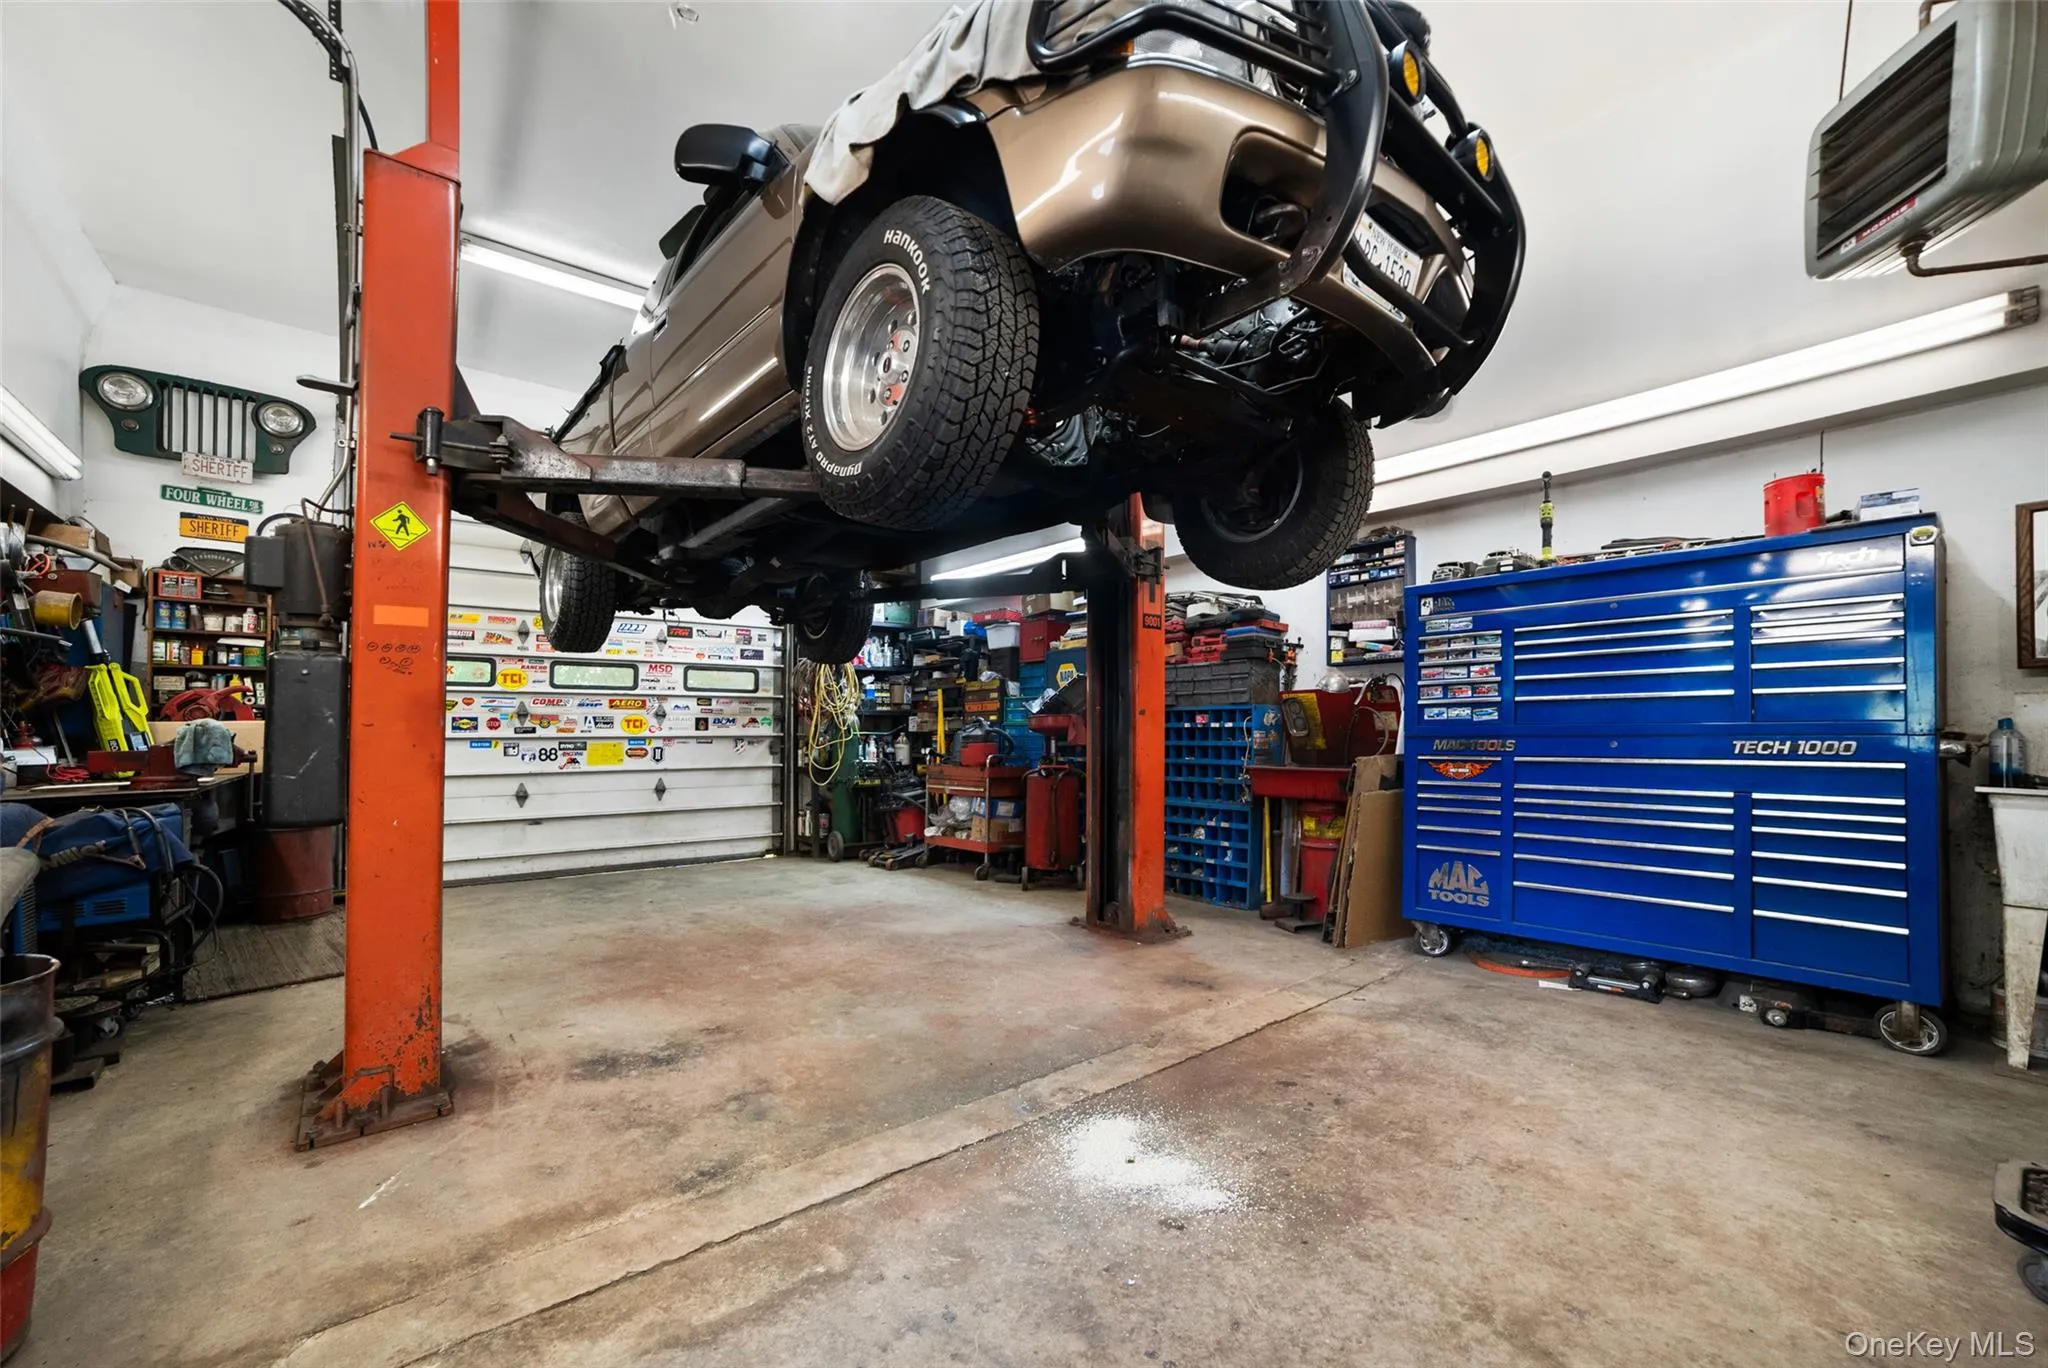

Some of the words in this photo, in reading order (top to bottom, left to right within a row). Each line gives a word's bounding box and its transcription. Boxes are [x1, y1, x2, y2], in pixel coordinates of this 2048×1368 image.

[192, 459, 249, 479] SHERIFF
[165, 487, 200, 503] FOUR
[206, 494, 248, 511] WHEEL
[189, 519, 240, 537] SHERIFF
[648, 664, 673, 673] MSD
[500, 673, 522, 684] TCI
[532, 698, 563, 706] COMP
[611, 699, 642, 707] AERO
[624, 719, 643, 729] TCI
[1470, 739, 1516, 751] TOOLS
[1732, 739, 1790, 755] TECH
[1796, 740, 1857, 756] 1000
[538, 747, 558, 762] 88
[1428, 860, 1489, 896] MAC
[1428, 889, 1490, 907] TOOLS
